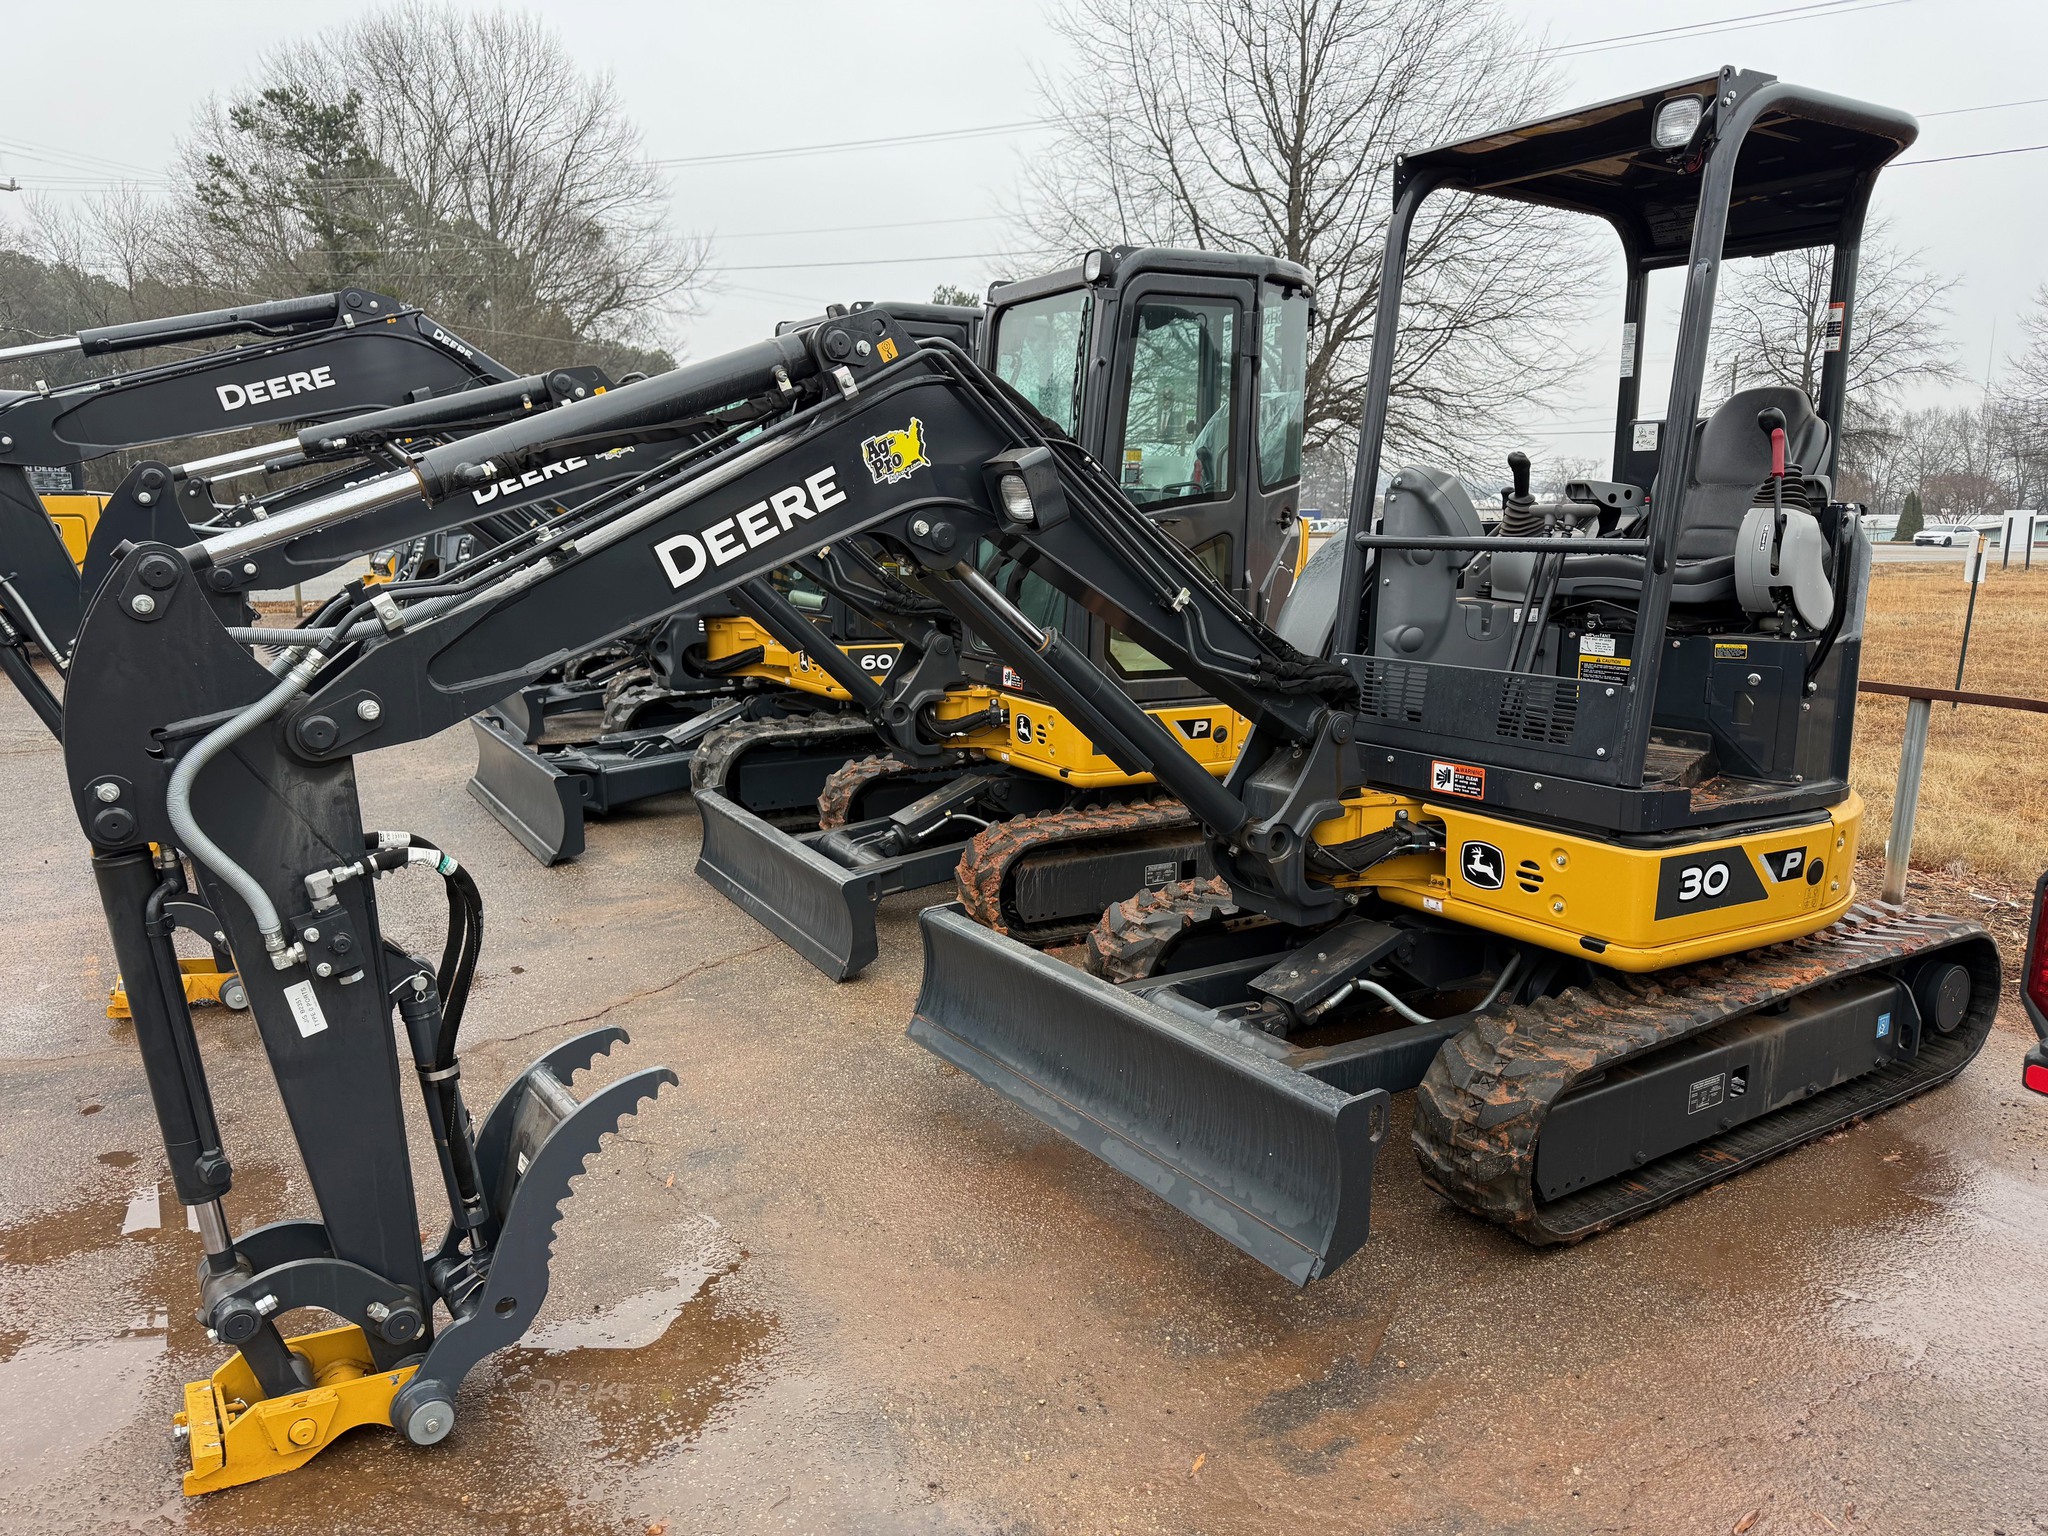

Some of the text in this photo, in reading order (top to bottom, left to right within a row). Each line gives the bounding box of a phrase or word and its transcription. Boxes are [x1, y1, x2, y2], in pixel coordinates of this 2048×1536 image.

[215, 365, 336, 412] DEERE
[866, 438, 895, 462] Ag-
[872, 453, 903, 479] Pro
[472, 456, 588, 505] DEERE
[654, 465, 848, 589] DEERE
[860, 653, 894, 670] 60
[1192, 720, 1209, 737] P
[1679, 851, 1802, 901] 30 P
